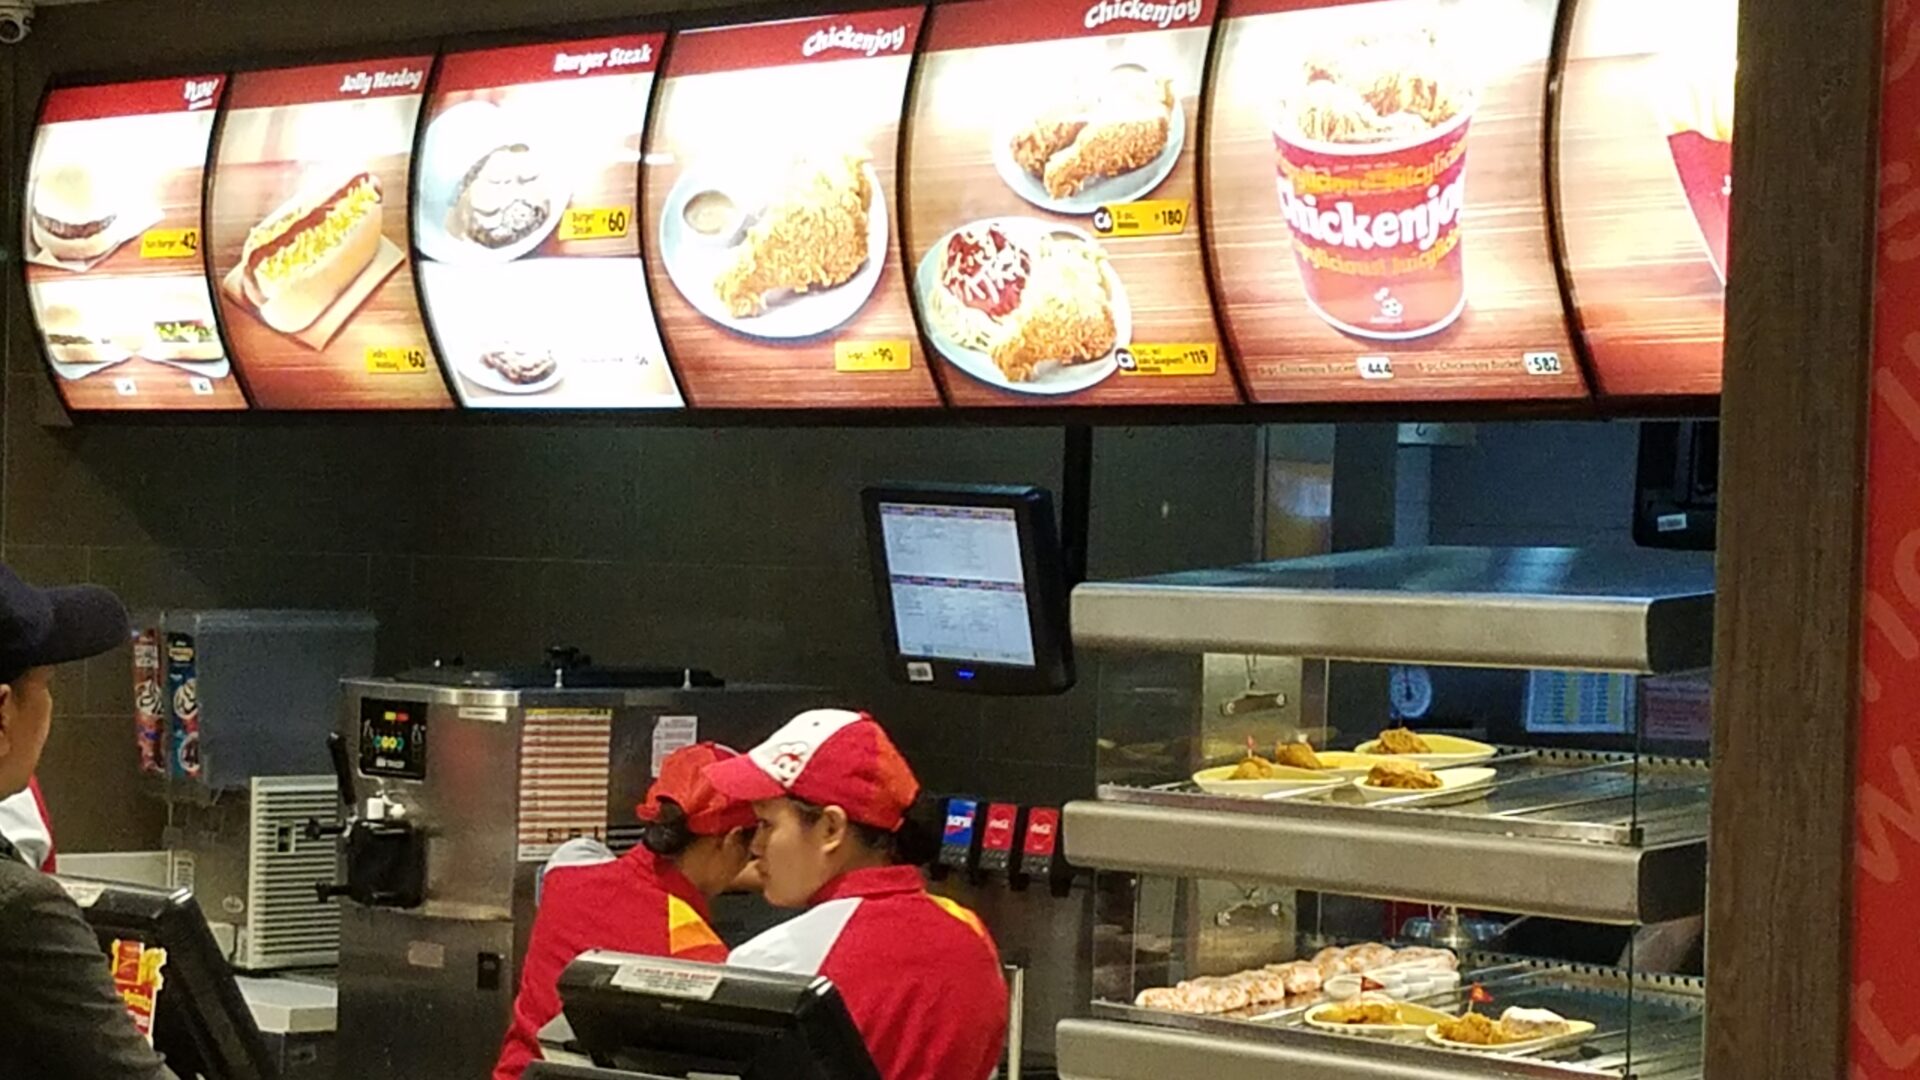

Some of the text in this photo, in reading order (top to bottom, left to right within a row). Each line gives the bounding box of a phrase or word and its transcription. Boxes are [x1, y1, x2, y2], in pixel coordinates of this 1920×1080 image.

[1084, 0, 1202, 28] Chickenjoy
[802, 25, 906, 57] Chickenjoy
[553, 43, 652, 75] Burger Steak
[339, 70, 423, 94] Jolly Hotdog
[608, 210, 626, 232] 60
